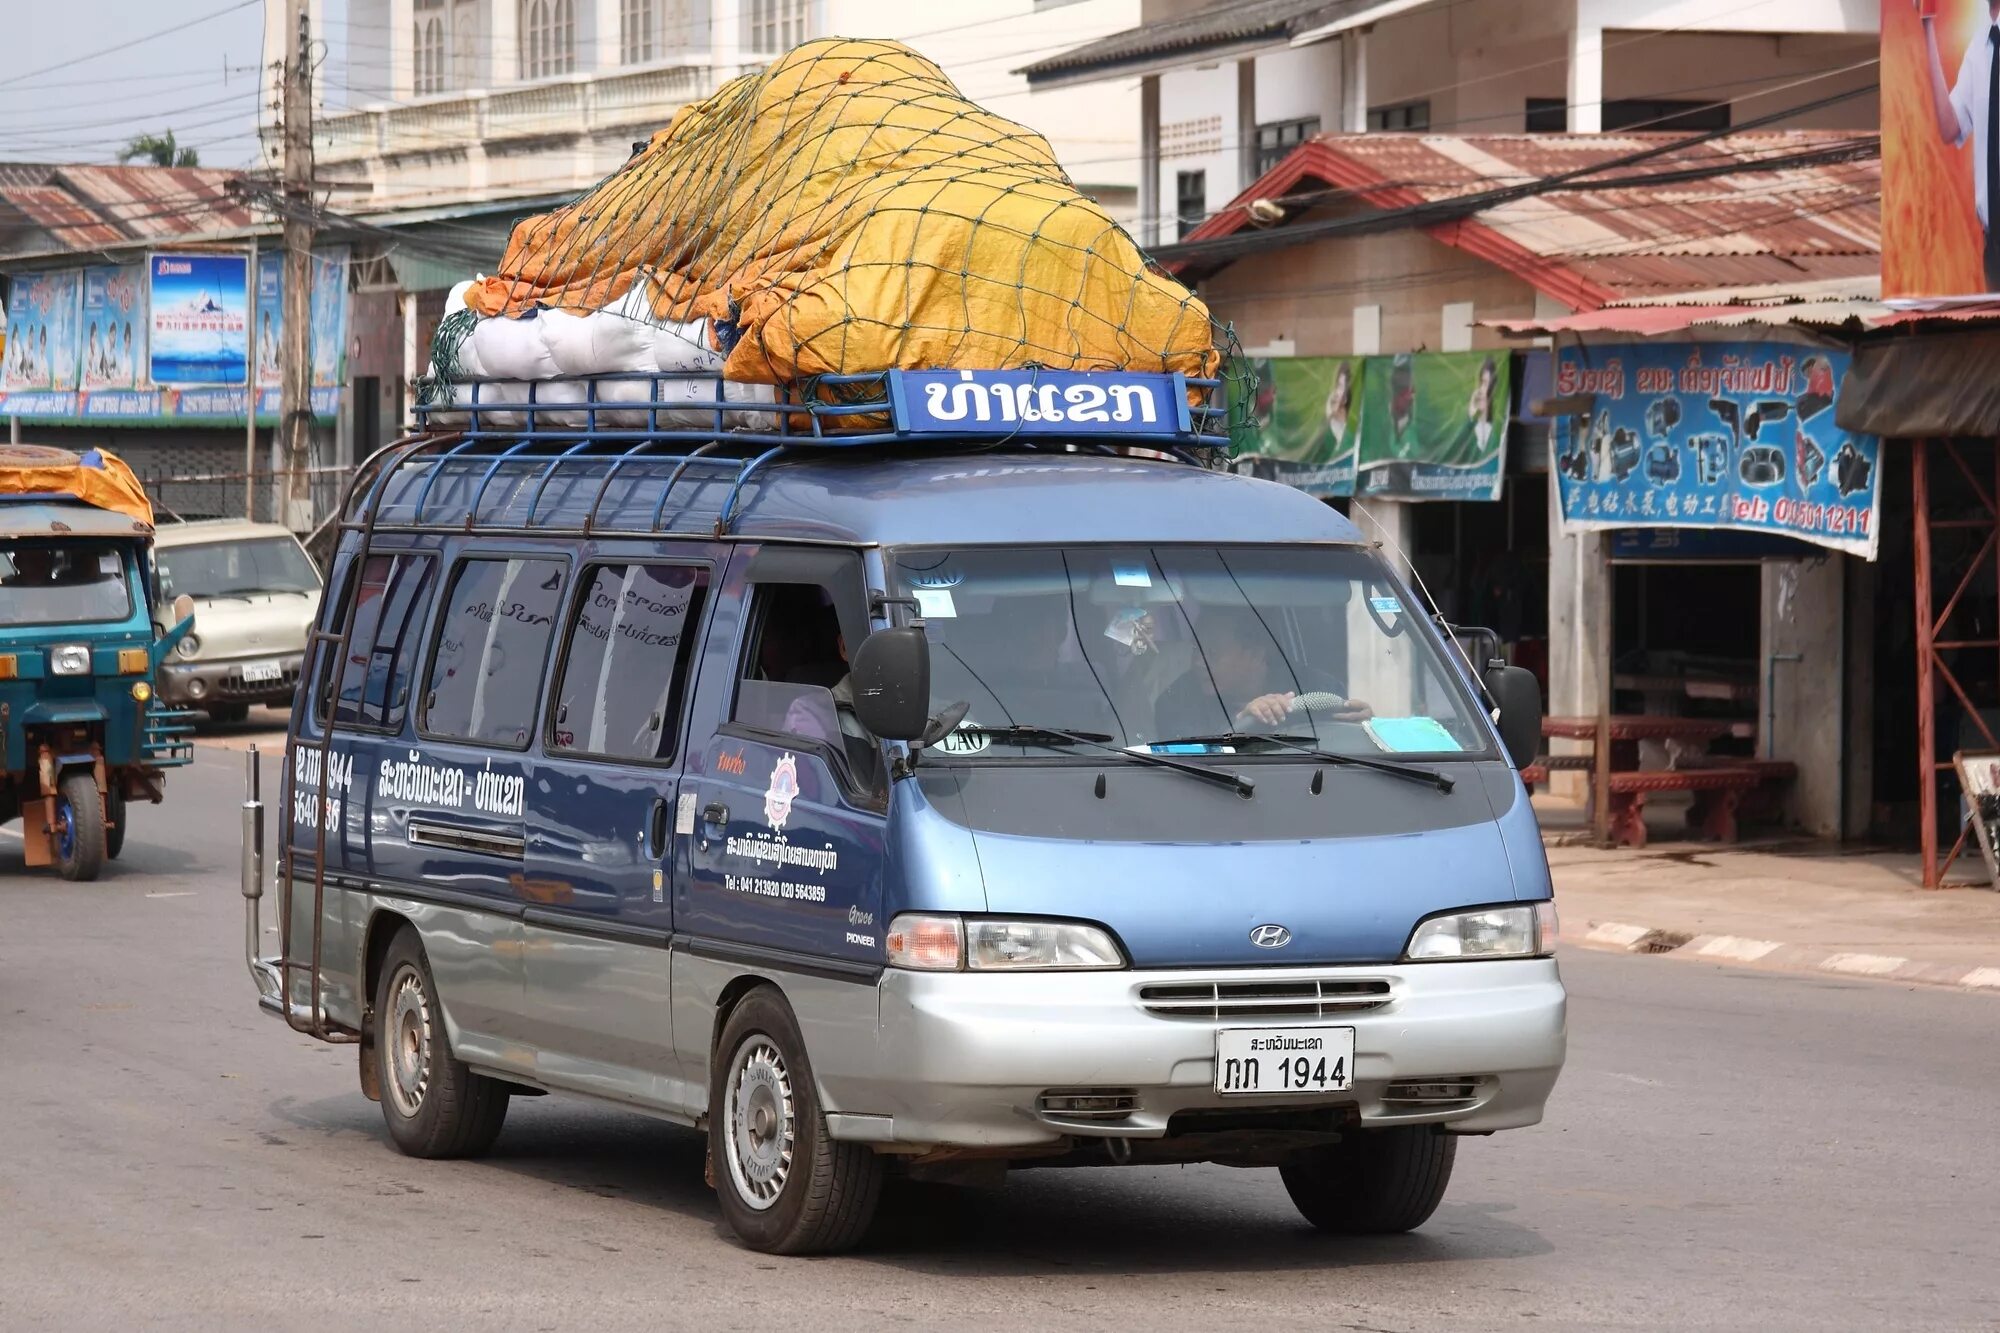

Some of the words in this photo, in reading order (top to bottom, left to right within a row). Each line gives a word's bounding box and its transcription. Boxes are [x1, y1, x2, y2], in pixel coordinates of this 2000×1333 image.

[925, 370, 1157, 423] ທ່າແຂກ
[943, 724, 984, 752] LAO
[740, 877, 753, 893] 041
[754, 879, 780, 898] 213920
[781, 882, 794, 899] 020
[795, 883, 826, 903] 5643859
[848, 904, 874, 927] Grace
[846, 931, 876, 948] PIONEER
[1251, 1035, 1323, 1051] ສະຫວັນນະເຂດ
[1224, 1057, 1259, 1089] ກກ
[1278, 1056, 1346, 1089] 1944
